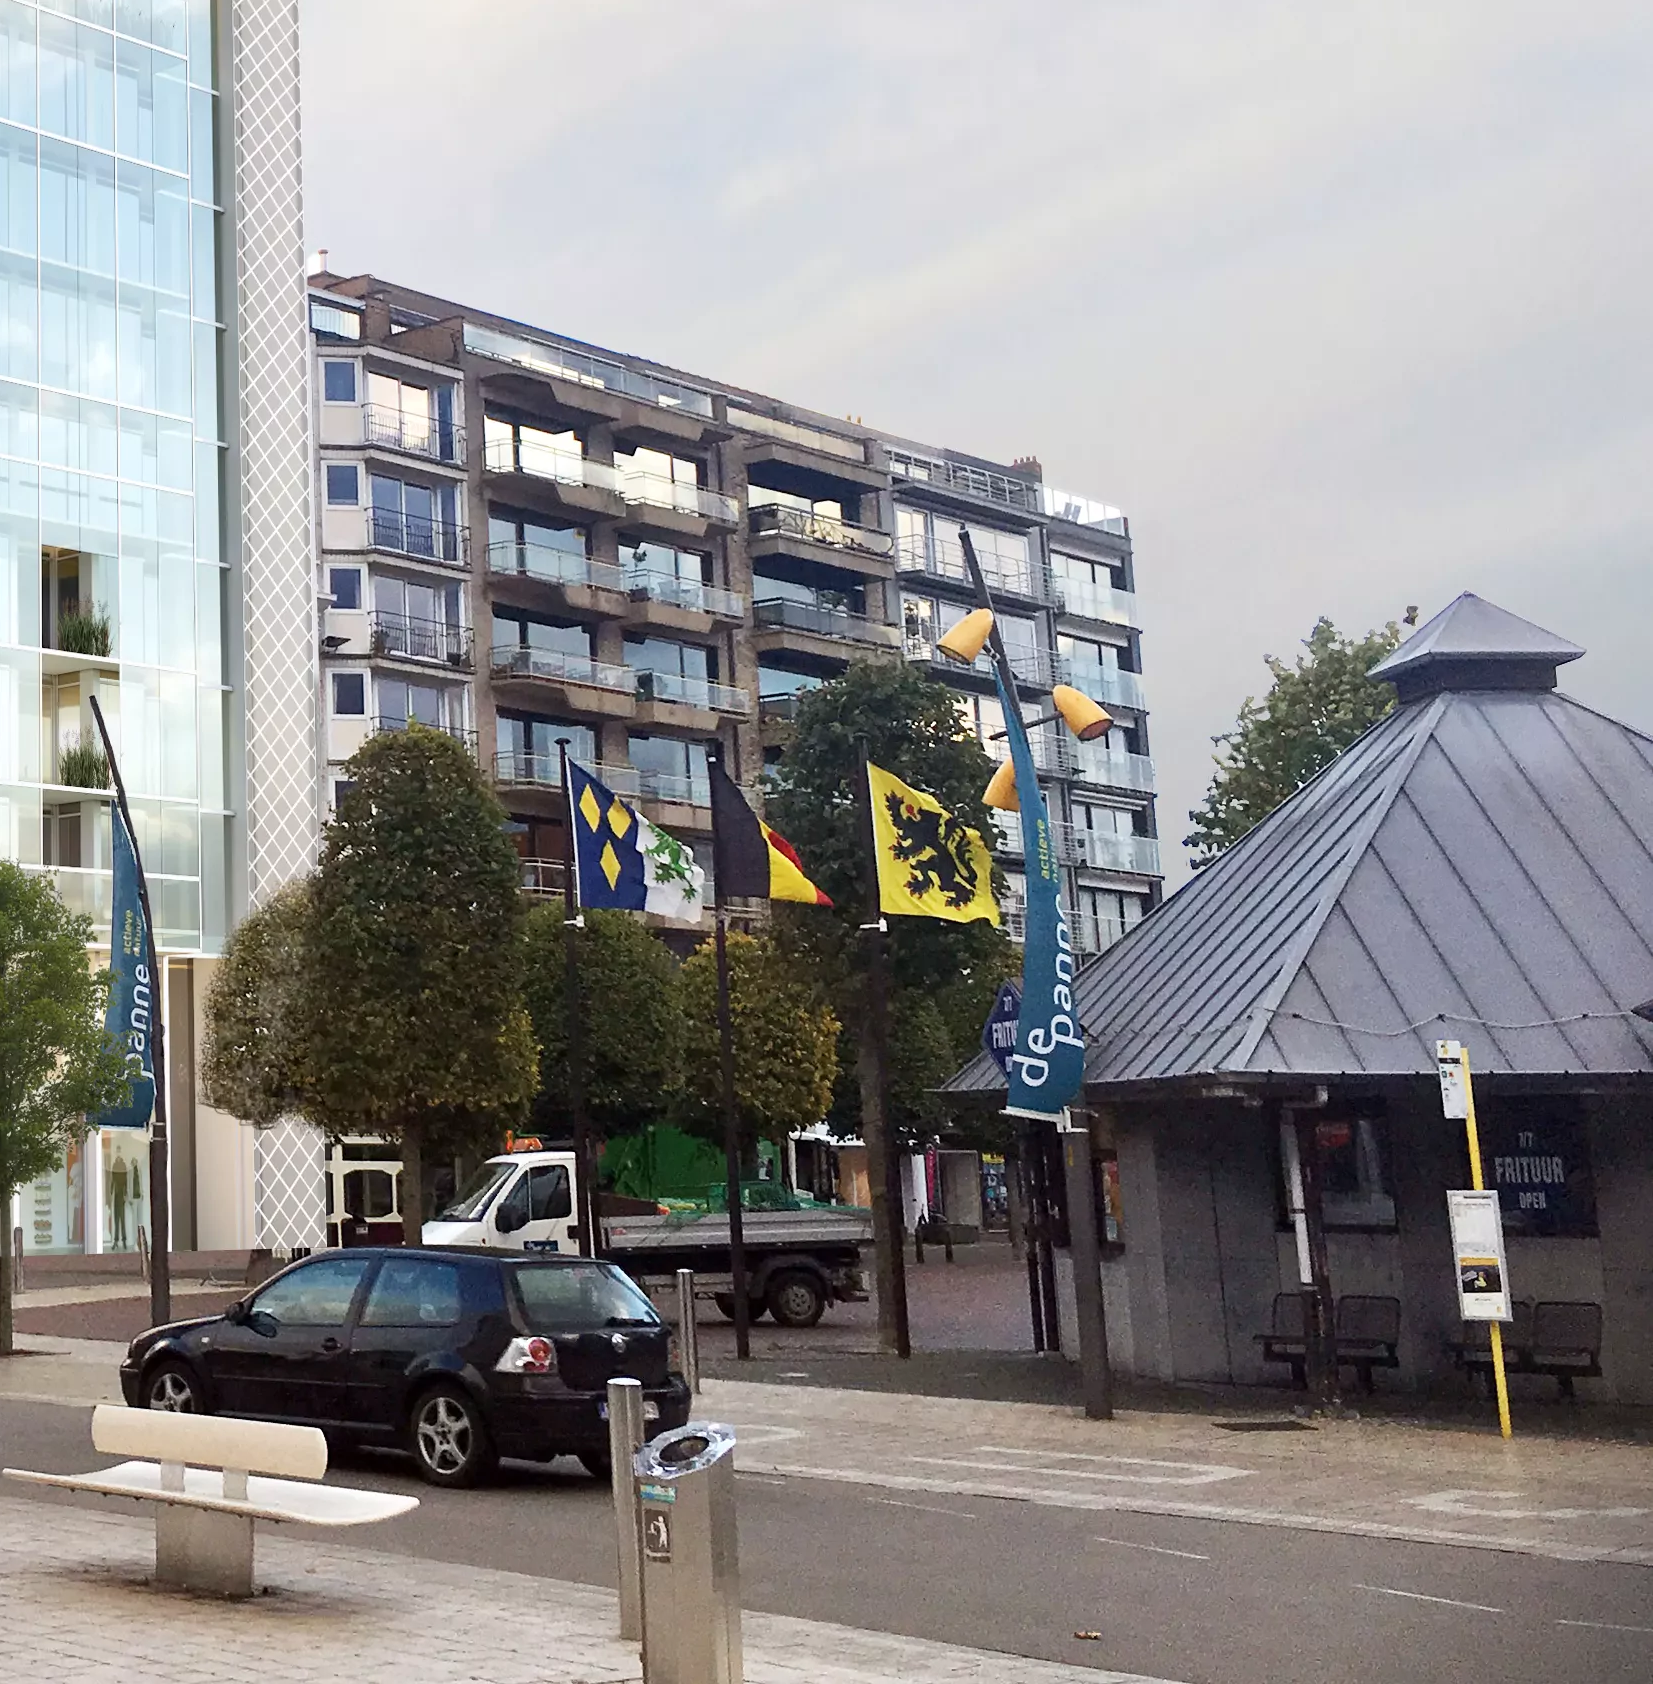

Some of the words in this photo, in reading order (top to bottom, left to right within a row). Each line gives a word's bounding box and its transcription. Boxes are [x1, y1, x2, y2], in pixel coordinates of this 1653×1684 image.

[1035, 819, 1050, 880] actieve
[123, 909, 133, 955] actieve
[124, 963, 155, 1079] panne
[991, 1019, 1019, 1049] FRITU
[1012, 1027, 1056, 1087] de
[1518, 1131, 1534, 1148] 7/7
[1495, 1156, 1565, 1184] FRITUUR
[1518, 1191, 1546, 1209] OPEN
